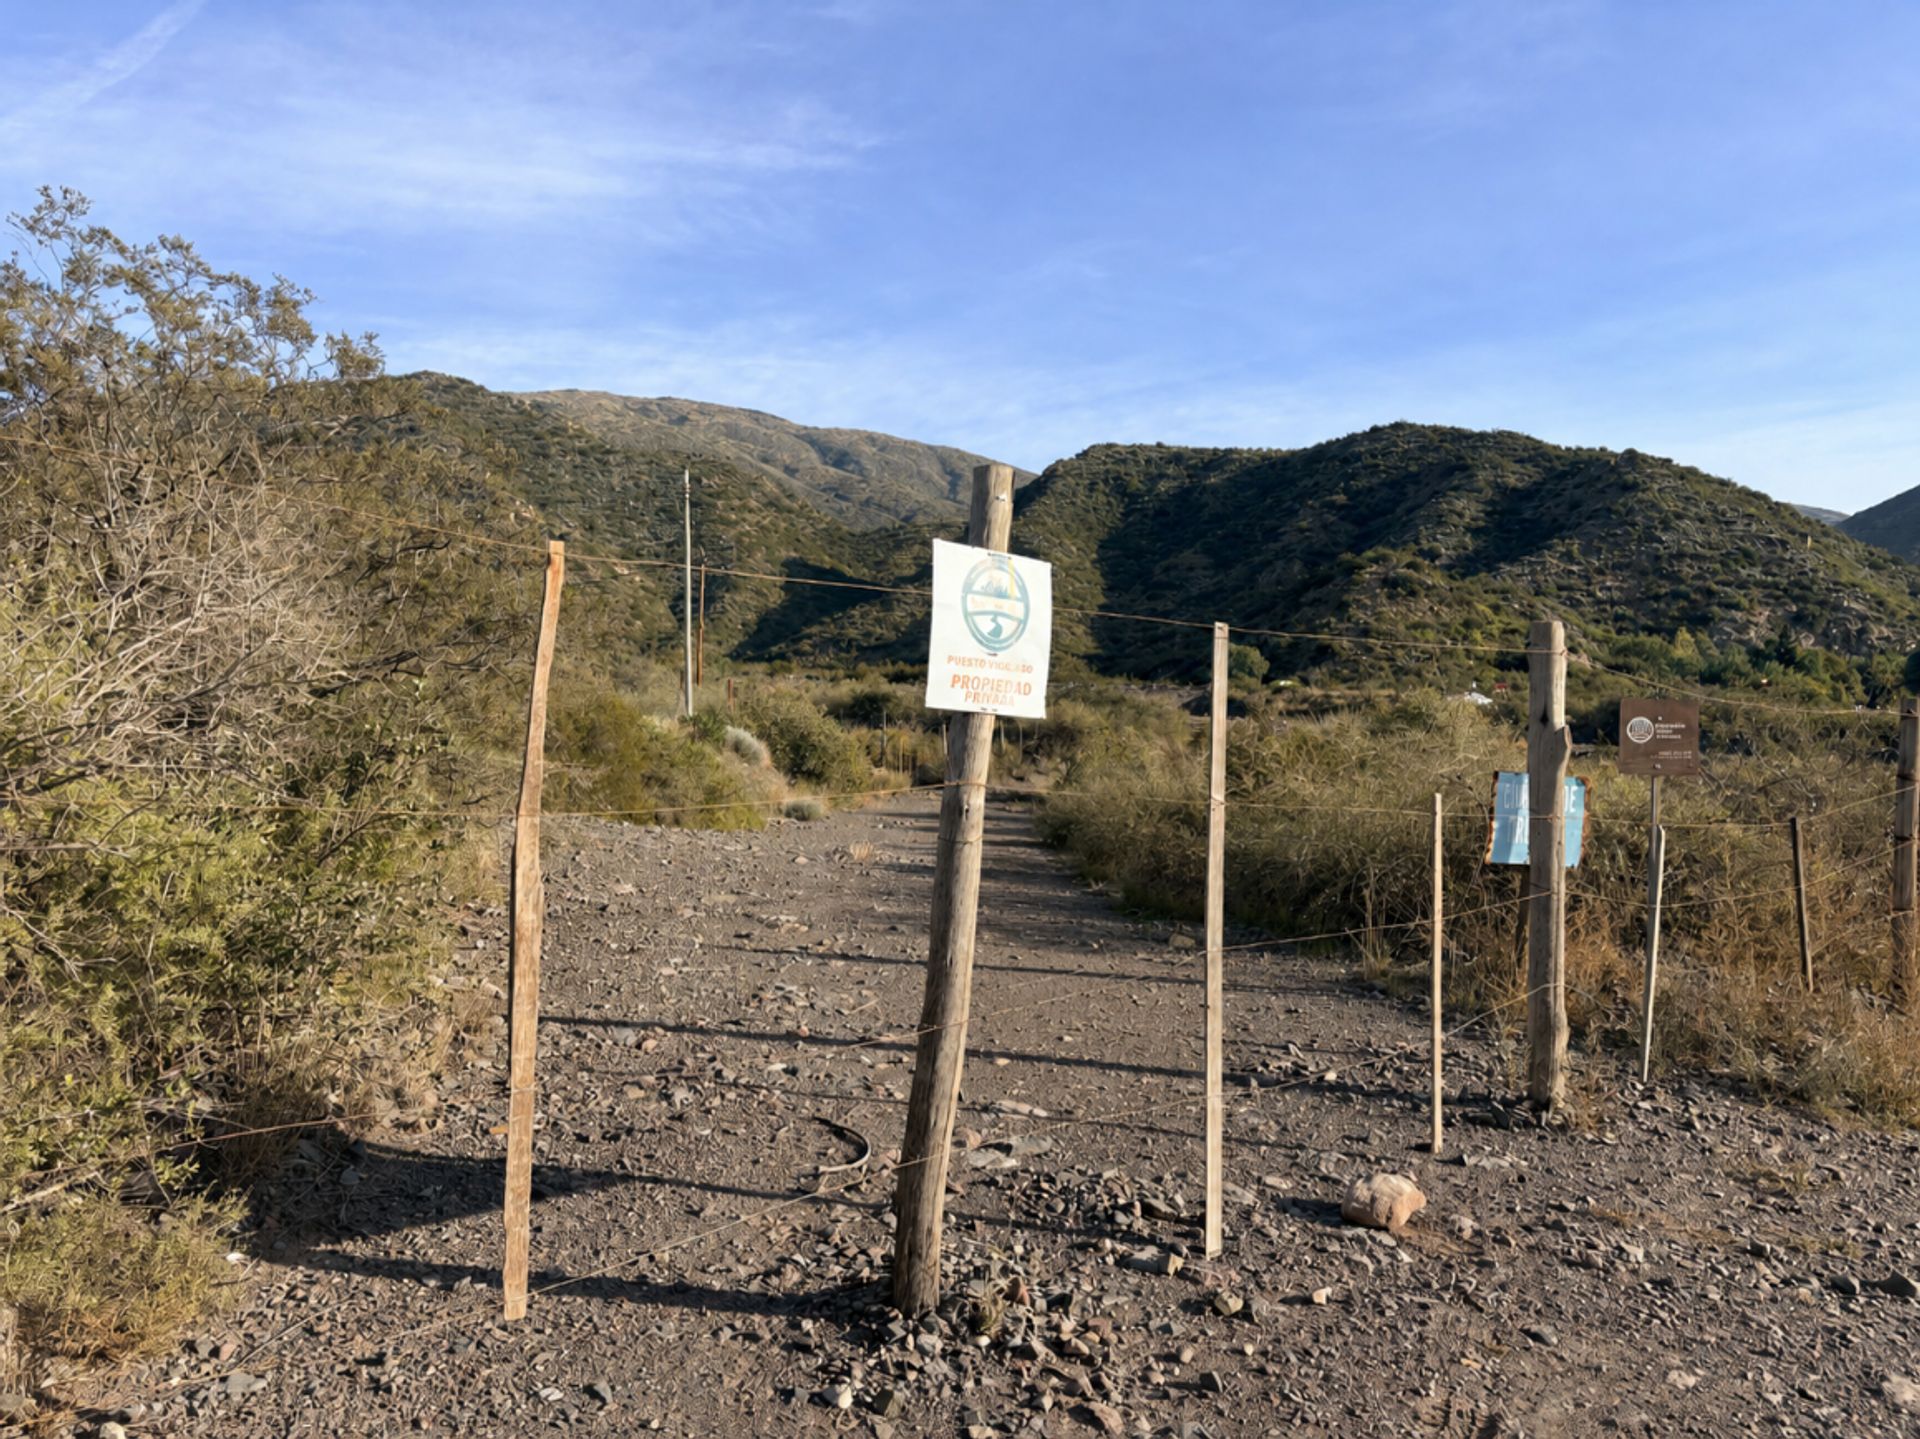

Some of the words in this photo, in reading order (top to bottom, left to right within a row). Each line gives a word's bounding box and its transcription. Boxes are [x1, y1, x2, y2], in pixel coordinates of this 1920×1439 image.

[947, 655, 987, 669] PUESTO
[950, 673, 1033, 696] PROPIEDAD
[964, 690, 1015, 706] PRIVADA
